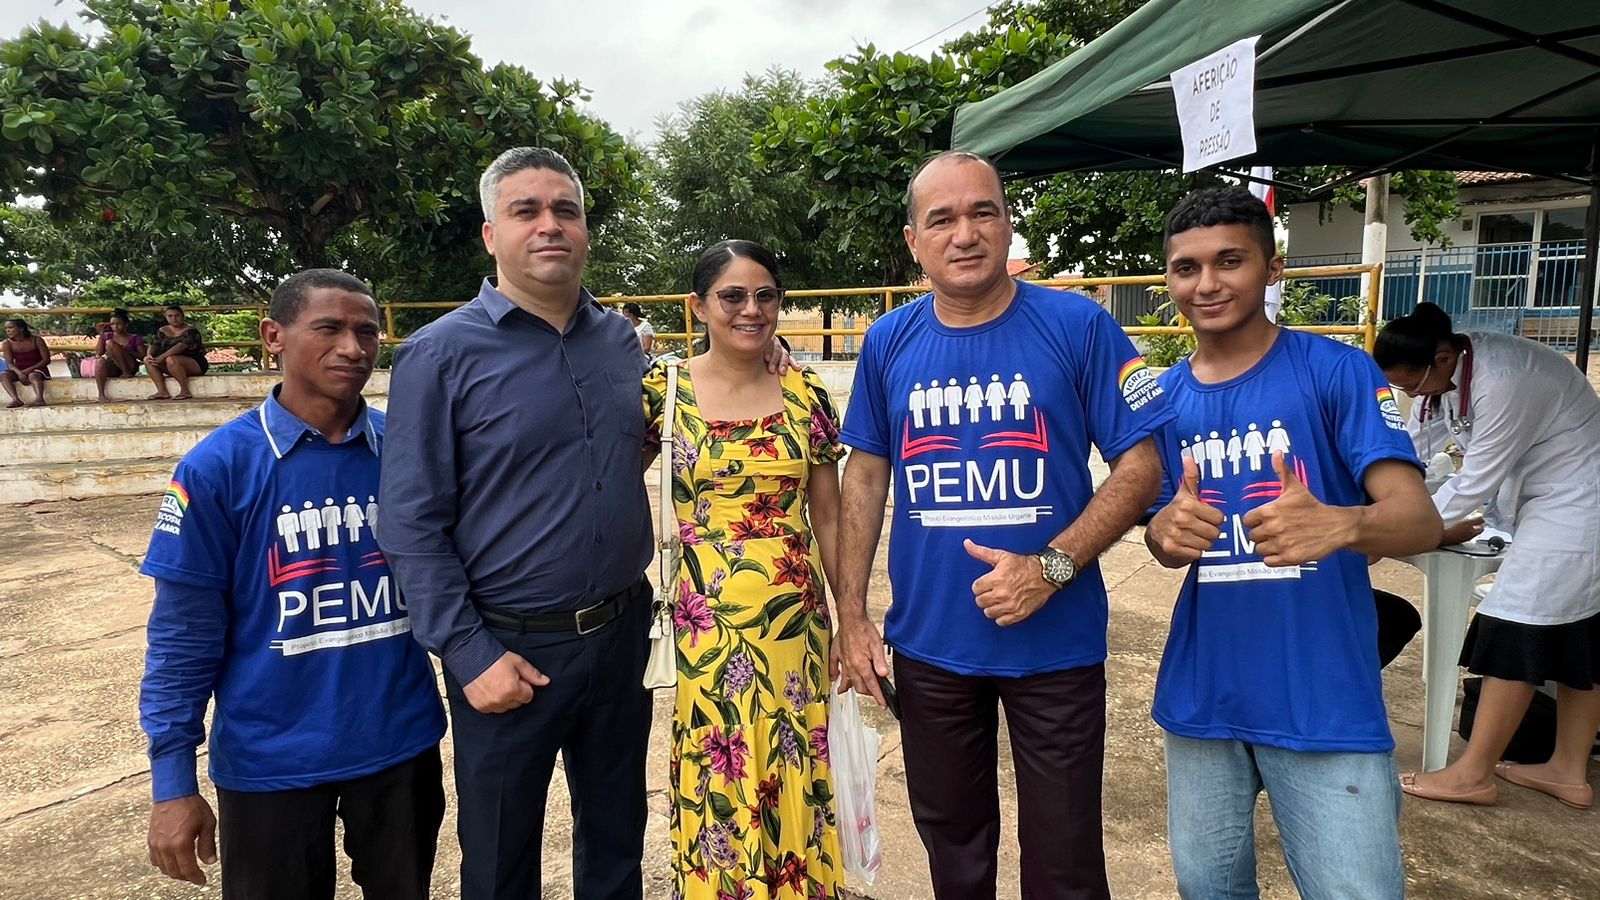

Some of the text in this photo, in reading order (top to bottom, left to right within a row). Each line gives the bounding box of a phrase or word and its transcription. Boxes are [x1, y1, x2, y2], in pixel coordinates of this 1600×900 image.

[1192, 54, 1238, 96] AFERIÇÃO
[1209, 100, 1221, 123] DE
[1199, 125, 1231, 158] PRESSÃO
[905, 457, 1045, 504] PEMU
